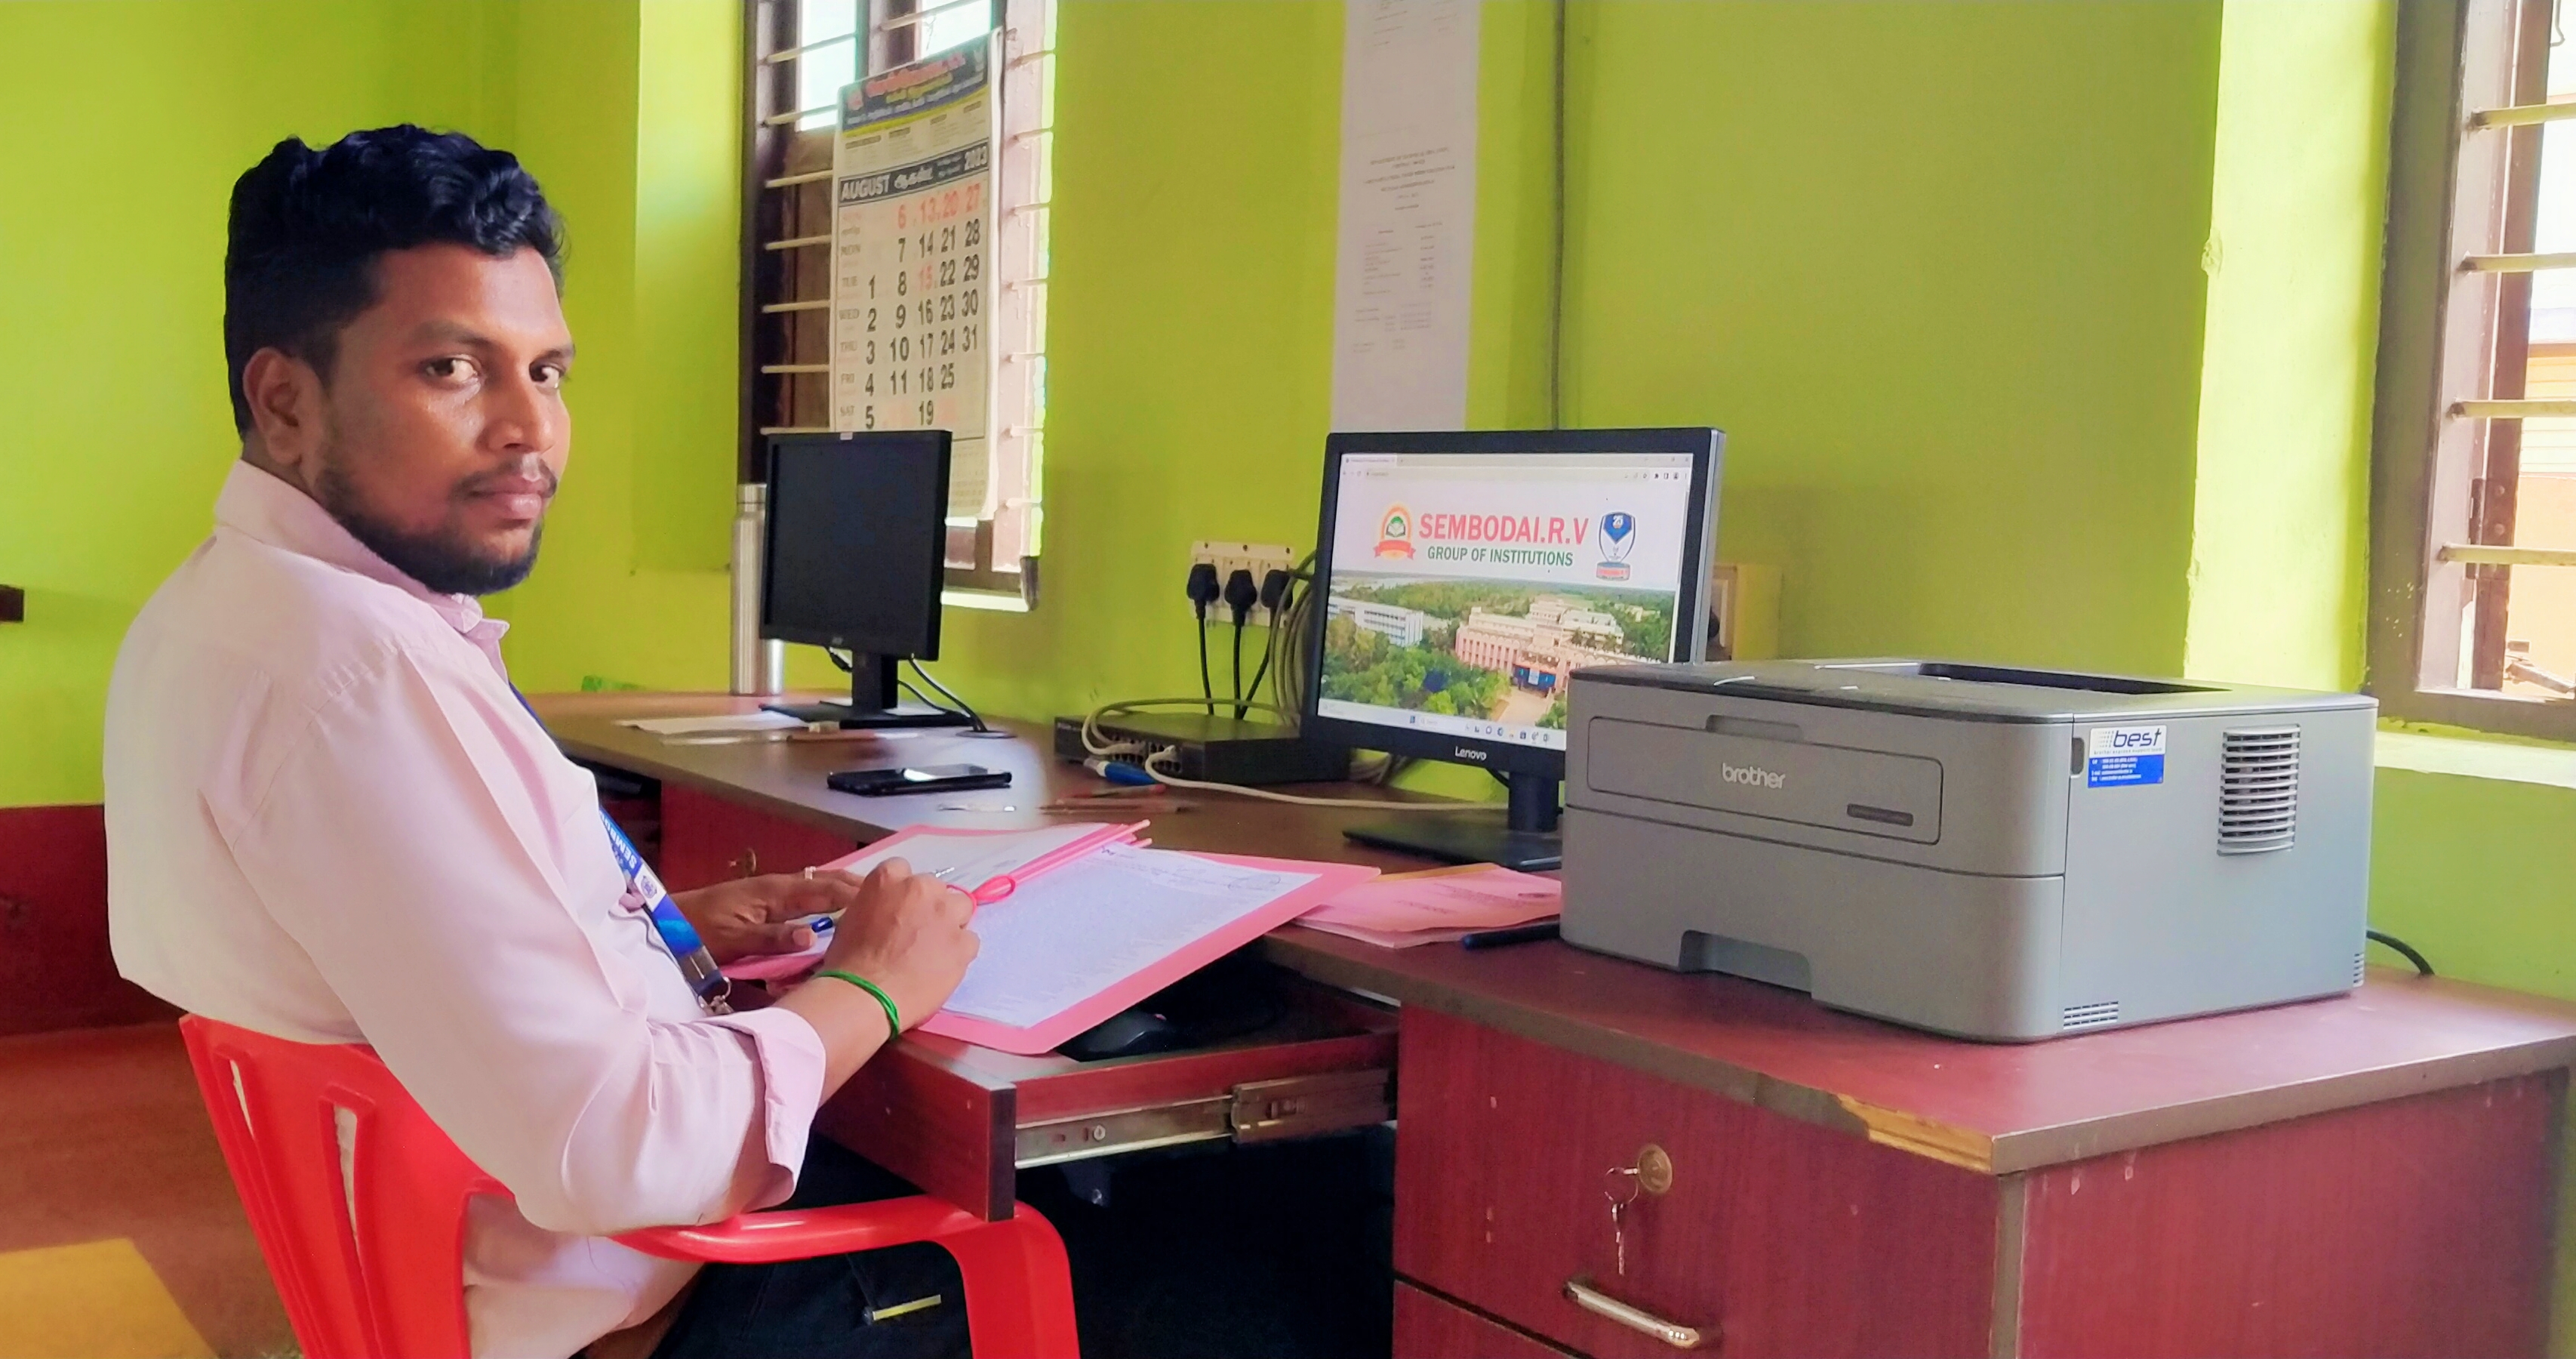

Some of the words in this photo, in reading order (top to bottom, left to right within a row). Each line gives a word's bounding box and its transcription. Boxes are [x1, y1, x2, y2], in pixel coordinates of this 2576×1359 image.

[841, 173, 891, 201] AUGUST
[897, 205, 906, 229] 6
[921, 197, 935, 223] 13
[966, 183, 980, 212] 27
[898, 237, 906, 263] 7
[919, 230, 934, 258] 14
[940, 225, 956, 253] 21
[965, 218, 980, 248] 28
[869, 275, 876, 299] 1
[897, 271, 906, 296] 8
[940, 259, 956, 287] 22
[963, 254, 980, 282] 29
[867, 308, 877, 332] 2
[896, 304, 906, 328] 9
[918, 299, 934, 325] 16
[940, 294, 956, 322] 23
[962, 288, 979, 317] 30
[866, 340, 875, 365] 3
[890, 337, 909, 362] 10
[919, 332, 934, 359] 17
[940, 329, 956, 356] 24
[962, 324, 977, 353] 31
[865, 373, 874, 396] 4
[890, 370, 906, 395] 11
[919, 367, 934, 393] 18
[940, 362, 955, 390] 25
[865, 405, 874, 430] 5
[919, 400, 934, 426] 19
[1427, 546, 1468, 561] GROUP
[1471, 547, 1486, 562] OF
[1490, 548, 1574, 567] INSTITUTIONS
[1454, 745, 1487, 761] Lenovo
[2113, 728, 2162, 747] best
[1722, 762, 1786, 789] brother
